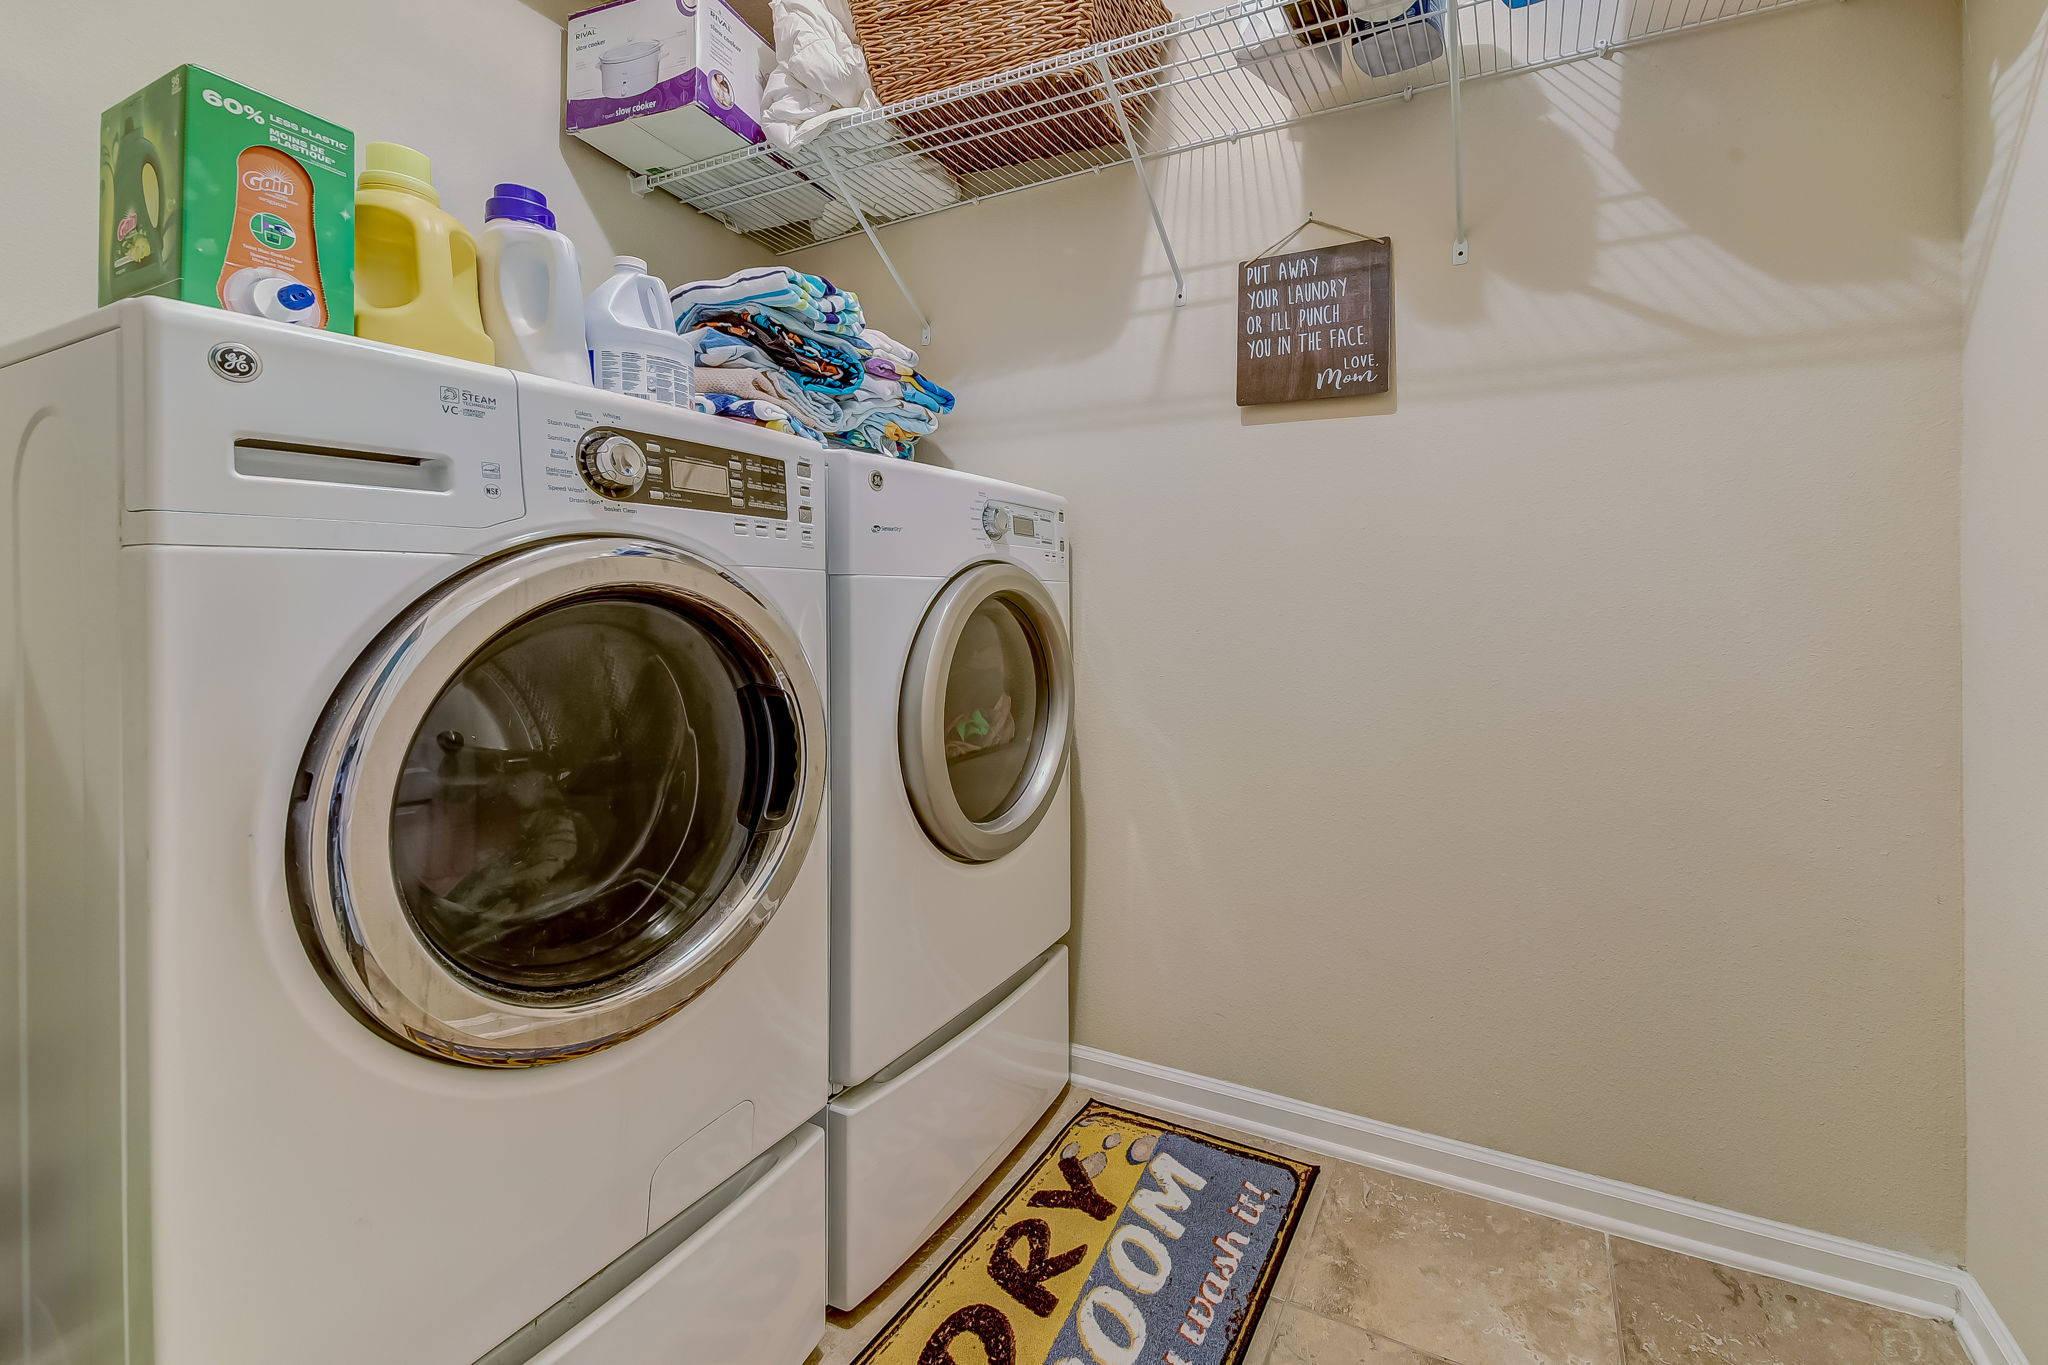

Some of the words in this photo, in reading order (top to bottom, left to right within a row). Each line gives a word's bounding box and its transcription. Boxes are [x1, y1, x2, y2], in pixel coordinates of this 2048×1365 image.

[710, 10, 733, 34] RIVAL
[575, 28, 598, 40] RIVAL
[575, 43, 588, 53] slow
[588, 39, 606, 50] cooker
[201, 88, 266, 125] 60%
[615, 104, 632, 117] slow
[632, 100, 657, 114] cooker
[269, 113, 299, 131] LESS
[269, 128, 308, 148] MOINS
[310, 144, 325, 155] DE
[242, 170, 295, 196] Gain
[1247, 264, 1271, 287] PUT
[1278, 255, 1319, 282] AWAY
[1247, 288, 1279, 311] YOUR
[1288, 277, 1348, 305] LAUNDRY
[1246, 315, 1263, 335] OR
[1271, 311, 1291, 332] I'LL
[1298, 303, 1340, 328] PUNCH
[1246, 338, 1272, 360] YOU
[1277, 335, 1291, 356] IN
[1298, 330, 1323, 353] THE
[1329, 325, 1369, 349] FACE.
[1316, 367, 1379, 390] Mom
[461, 392, 497, 406] STEAM
[462, 400, 497, 411] TECHNOLOGY
[441, 404, 459, 416] VC
[574, 409, 593, 418] Colors
[602, 412, 622, 421] Whites
[547, 418, 563, 427] Stain
[563, 421, 581, 430] Wash
[547, 433, 572, 443] Sanitize
[550, 448, 568, 457] Bulky
[545, 466, 573, 476] Delicates
[547, 485, 567, 494] Speed
[603, 506, 621, 514] Basket
[1050, 1151, 1208, 1365] OOM
[1177, 1231, 1251, 1347] wash
